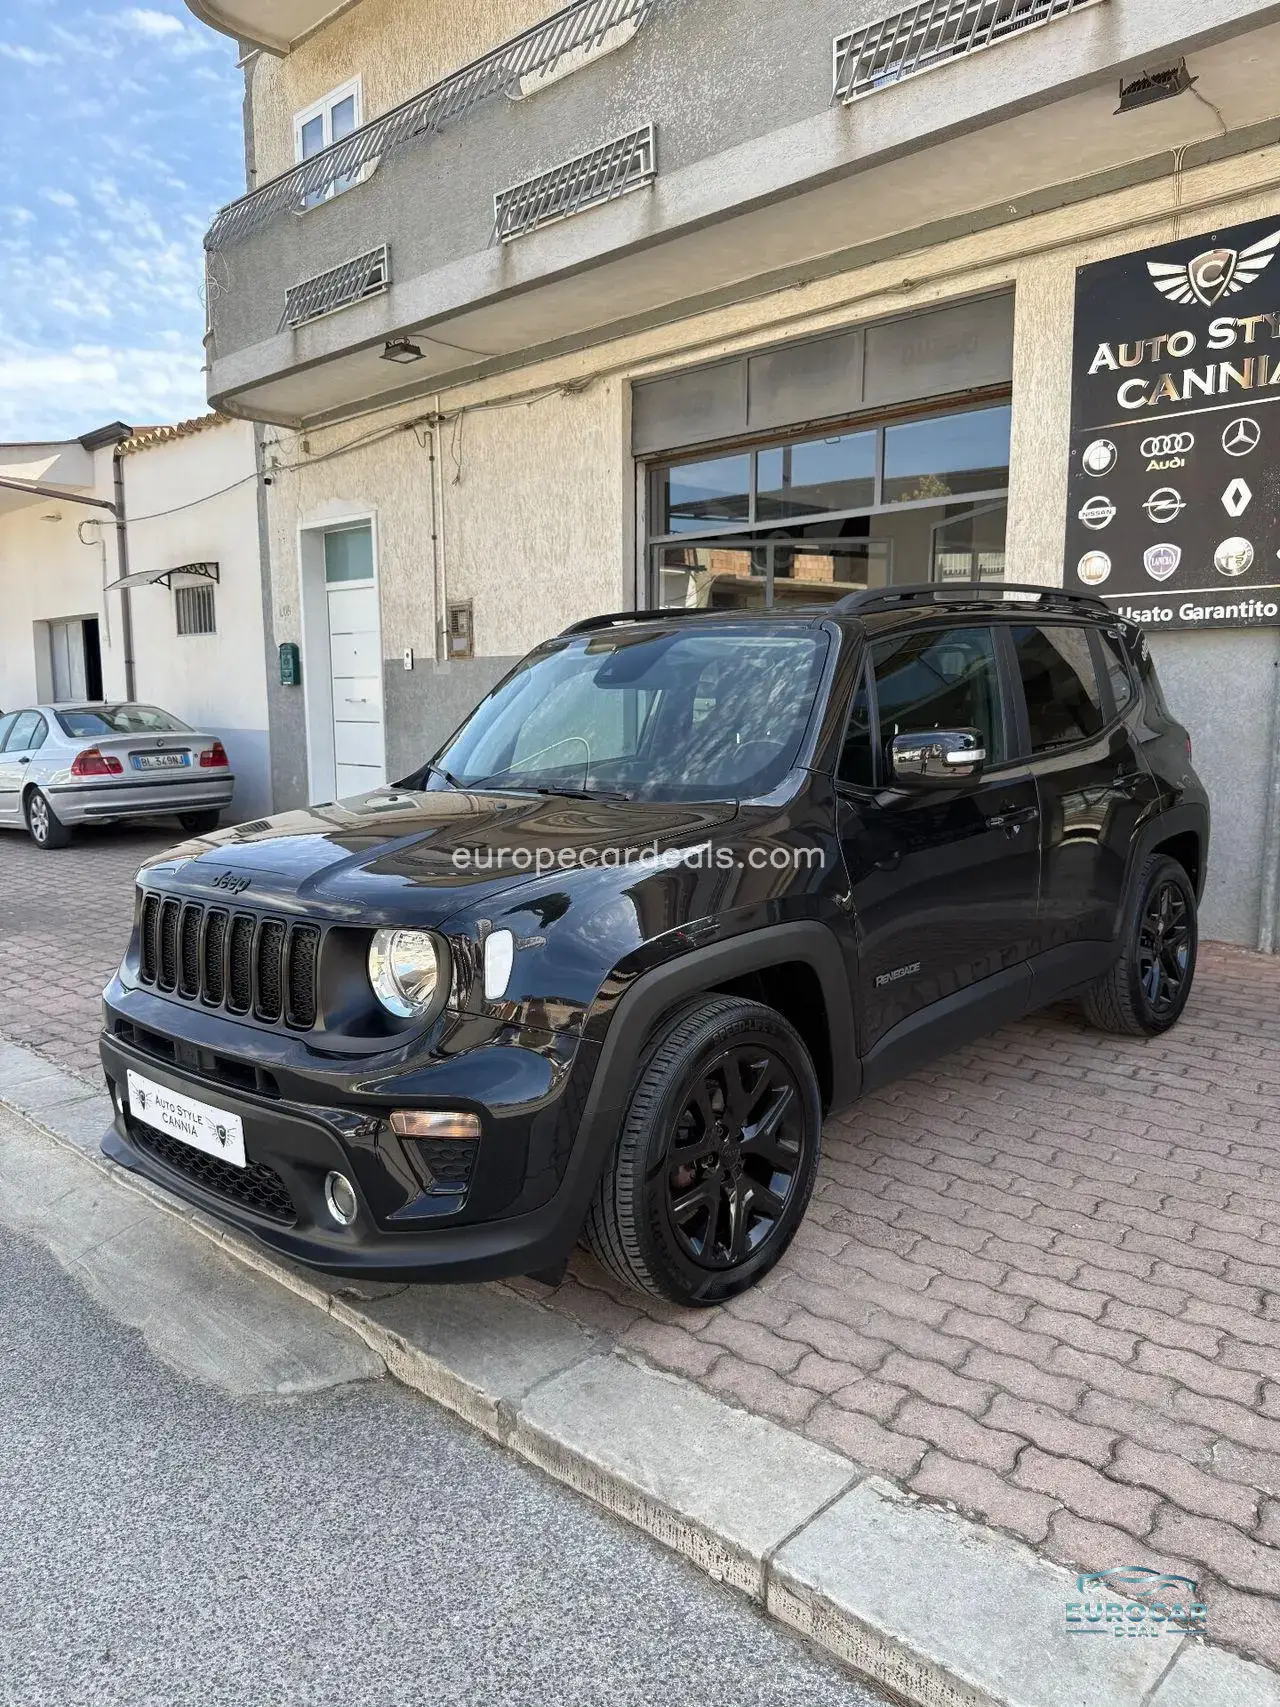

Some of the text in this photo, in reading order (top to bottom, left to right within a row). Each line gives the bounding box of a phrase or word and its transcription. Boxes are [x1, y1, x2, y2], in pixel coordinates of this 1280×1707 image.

[1087, 330, 1196, 375] AUTO
[1145, 456, 1185, 472] Audi
[1082, 508, 1112, 517] NISSAN
[1118, 599, 1278, 623] Usato Garantito
[141, 757, 153, 767] BL
[210, 870, 252, 895] Jeep
[876, 961, 921, 987] RENEGADE
[155, 1095, 203, 1126] AUTO STYLE
[162, 1112, 198, 1138] CANNIA
